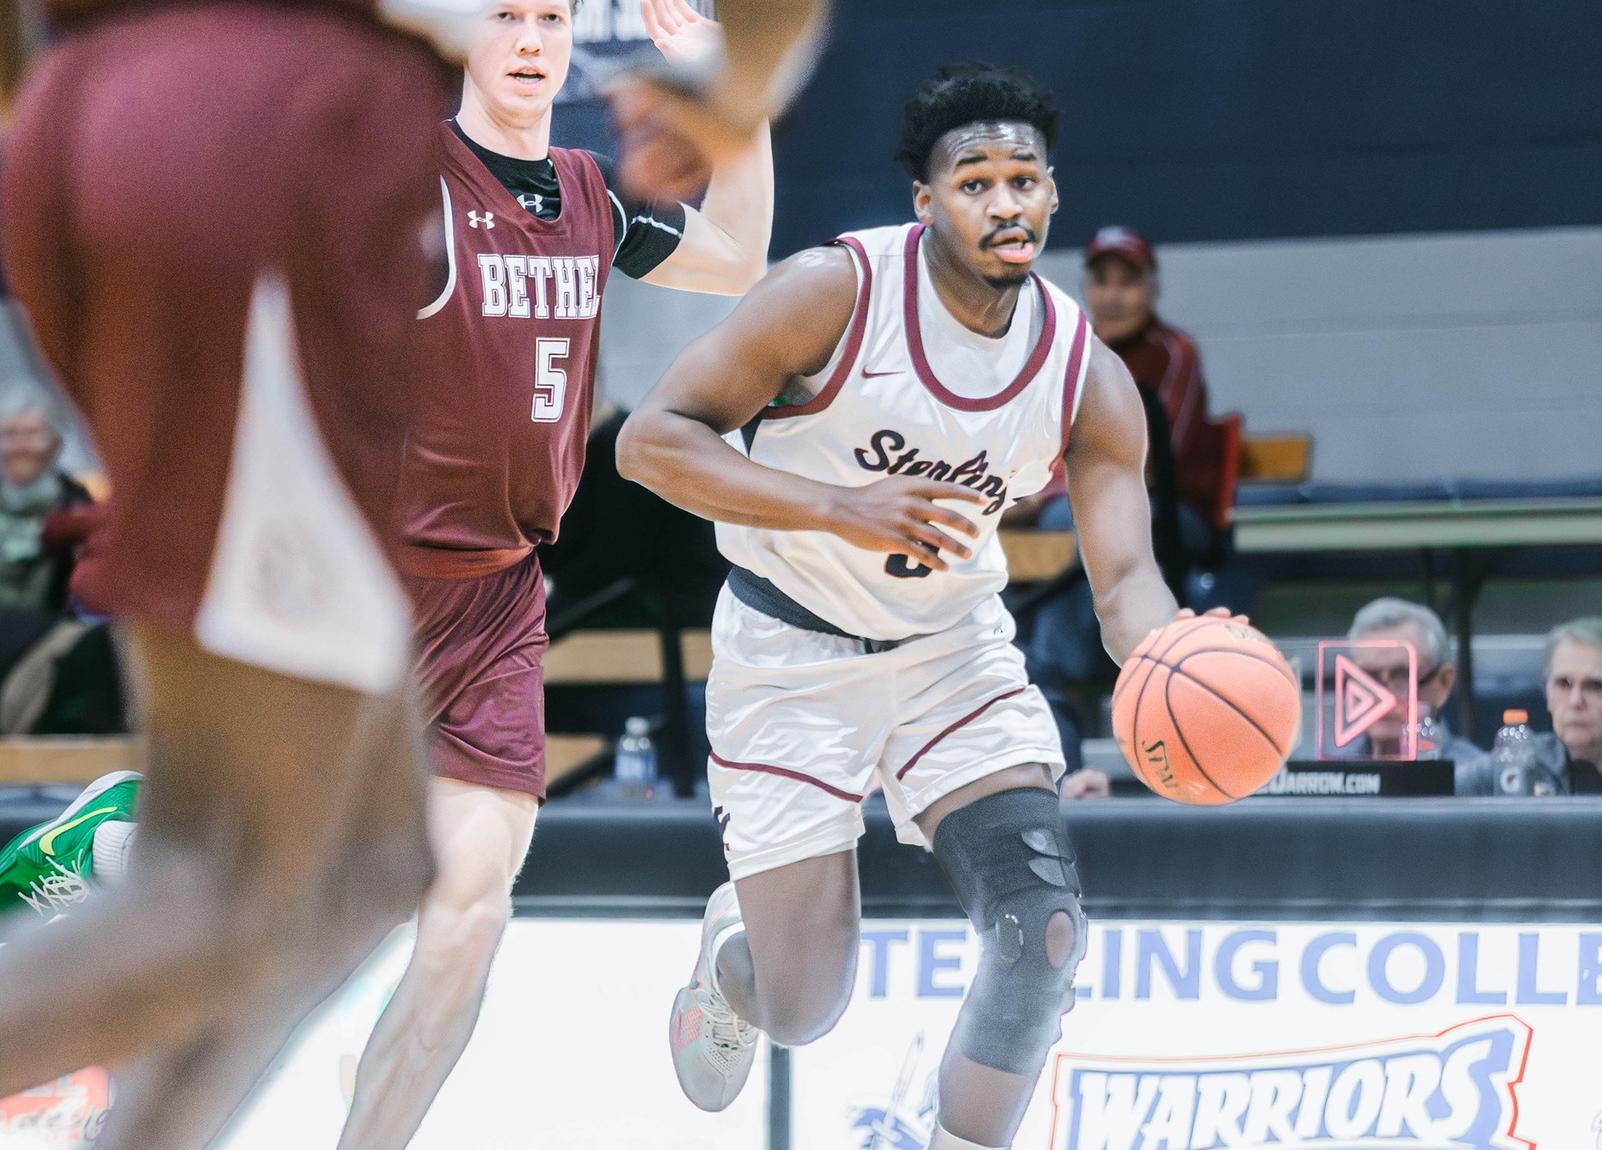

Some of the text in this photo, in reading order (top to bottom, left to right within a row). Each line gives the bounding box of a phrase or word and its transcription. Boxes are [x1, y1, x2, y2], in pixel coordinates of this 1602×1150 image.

[531, 337, 570, 422] 5
[860, 930, 1281, 1000] TEING
[1079, 1039, 1493, 1150] WARRIORS
